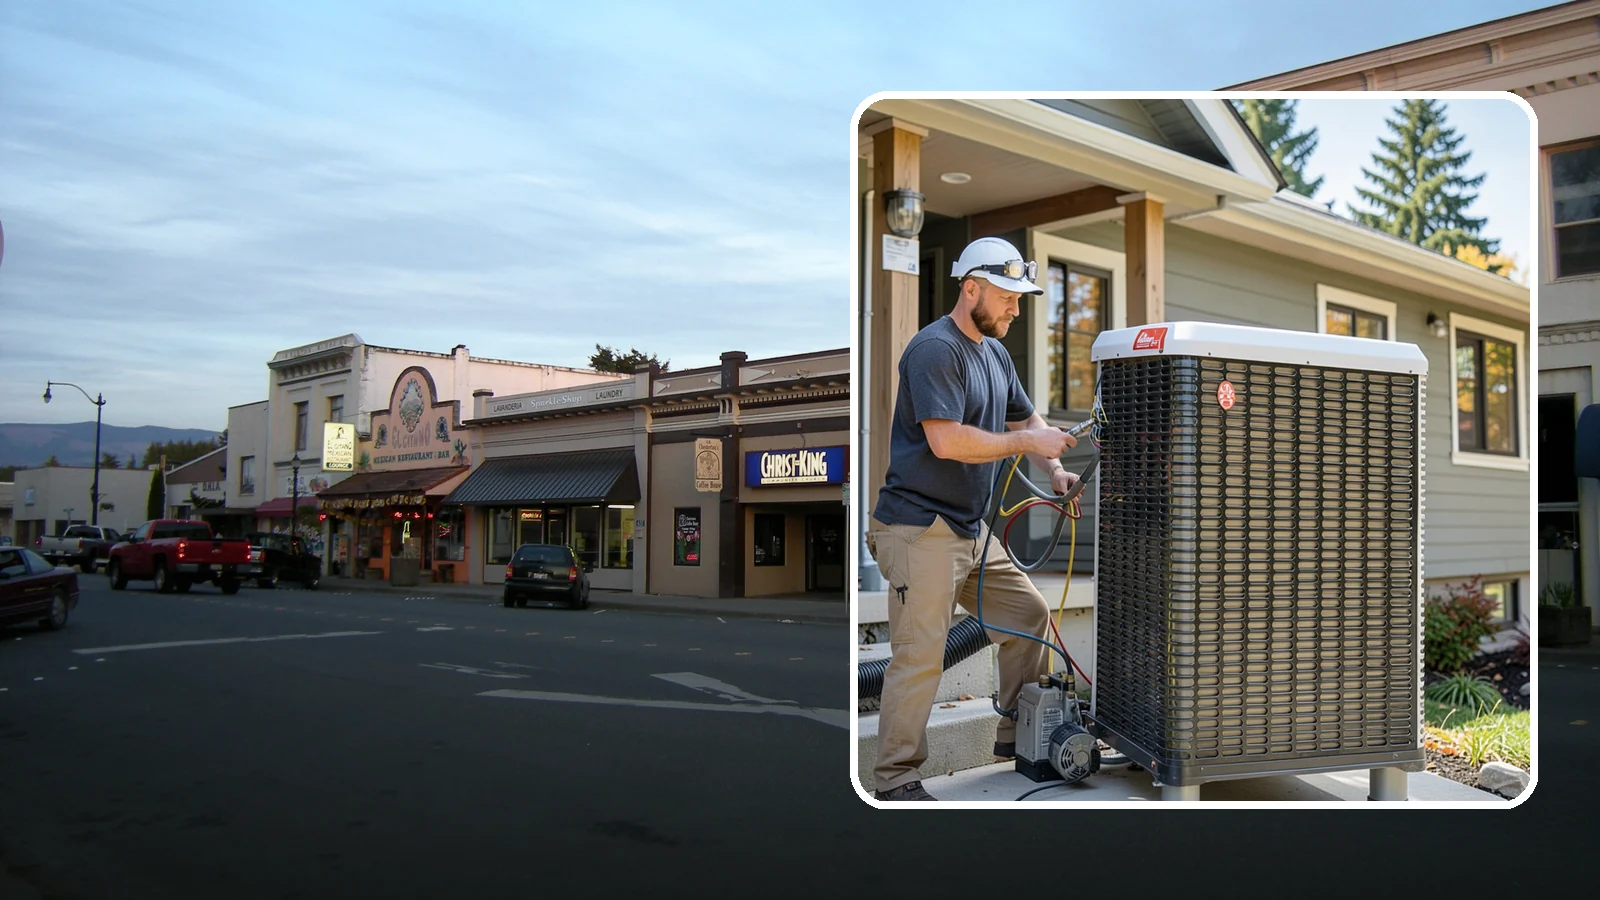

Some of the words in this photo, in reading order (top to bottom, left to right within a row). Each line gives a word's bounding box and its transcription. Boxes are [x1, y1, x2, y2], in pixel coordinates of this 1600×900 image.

[595, 388, 624, 400] LAUNDRY
[493, 402, 522, 412] LAVANDERIA
[531, 396, 560, 409] Sparkle
[561, 394, 582, 404] Shop
[373, 455, 397, 463] MEXICAN
[398, 452, 433, 462] RESTAURANT
[438, 450, 450, 459] BAR
[760, 452, 797, 478] CHRIST
[799, 450, 828, 476] KING
